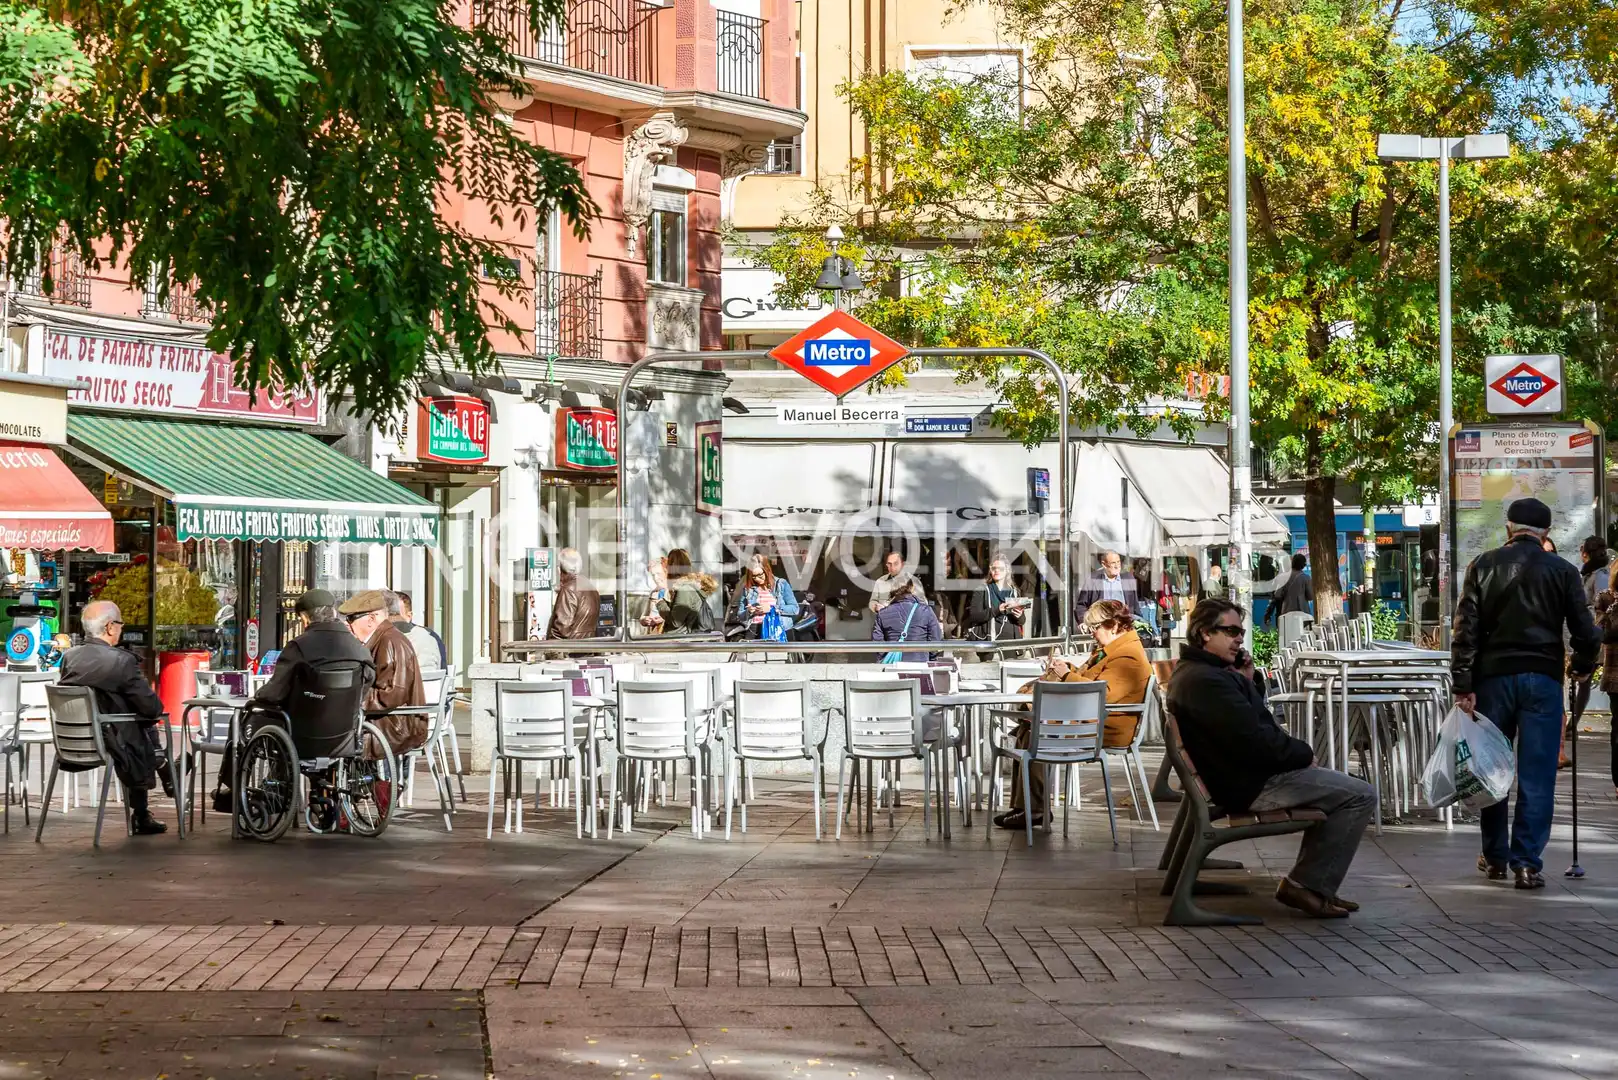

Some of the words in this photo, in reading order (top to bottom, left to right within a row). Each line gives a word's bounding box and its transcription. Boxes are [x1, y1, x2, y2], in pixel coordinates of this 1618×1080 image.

[78, 336, 96, 362] DE
[101, 339, 155, 368] PATATAS
[159, 345, 204, 373] FRITAS
[810, 344, 866, 360] Metro
[133, 381, 173, 407] SECOS
[1506, 380, 1541, 391] Metro
[433, 408, 458, 438] Café
[462, 410, 470, 440] &
[472, 410, 484, 440] Té
[784, 408, 836, 420] Manuel
[842, 408, 899, 420] Becerra
[570, 418, 592, 447] Café
[596, 420, 604, 448] &
[606, 420, 616, 449] Té
[31, 522, 81, 548] especiales
[180, 508, 202, 534] FCA.
[203, 509, 243, 535] PATATAS
[245, 511, 279, 536] FRITAS
[281, 512, 318, 538] FRUTOS
[320, 514, 350, 538] SECOS
[356, 516, 382, 539] HNOS.
[384, 517, 409, 540] ORTIZ
[412, 518, 436, 540] SANZ
[530, 565, 551, 580] MENÚ
